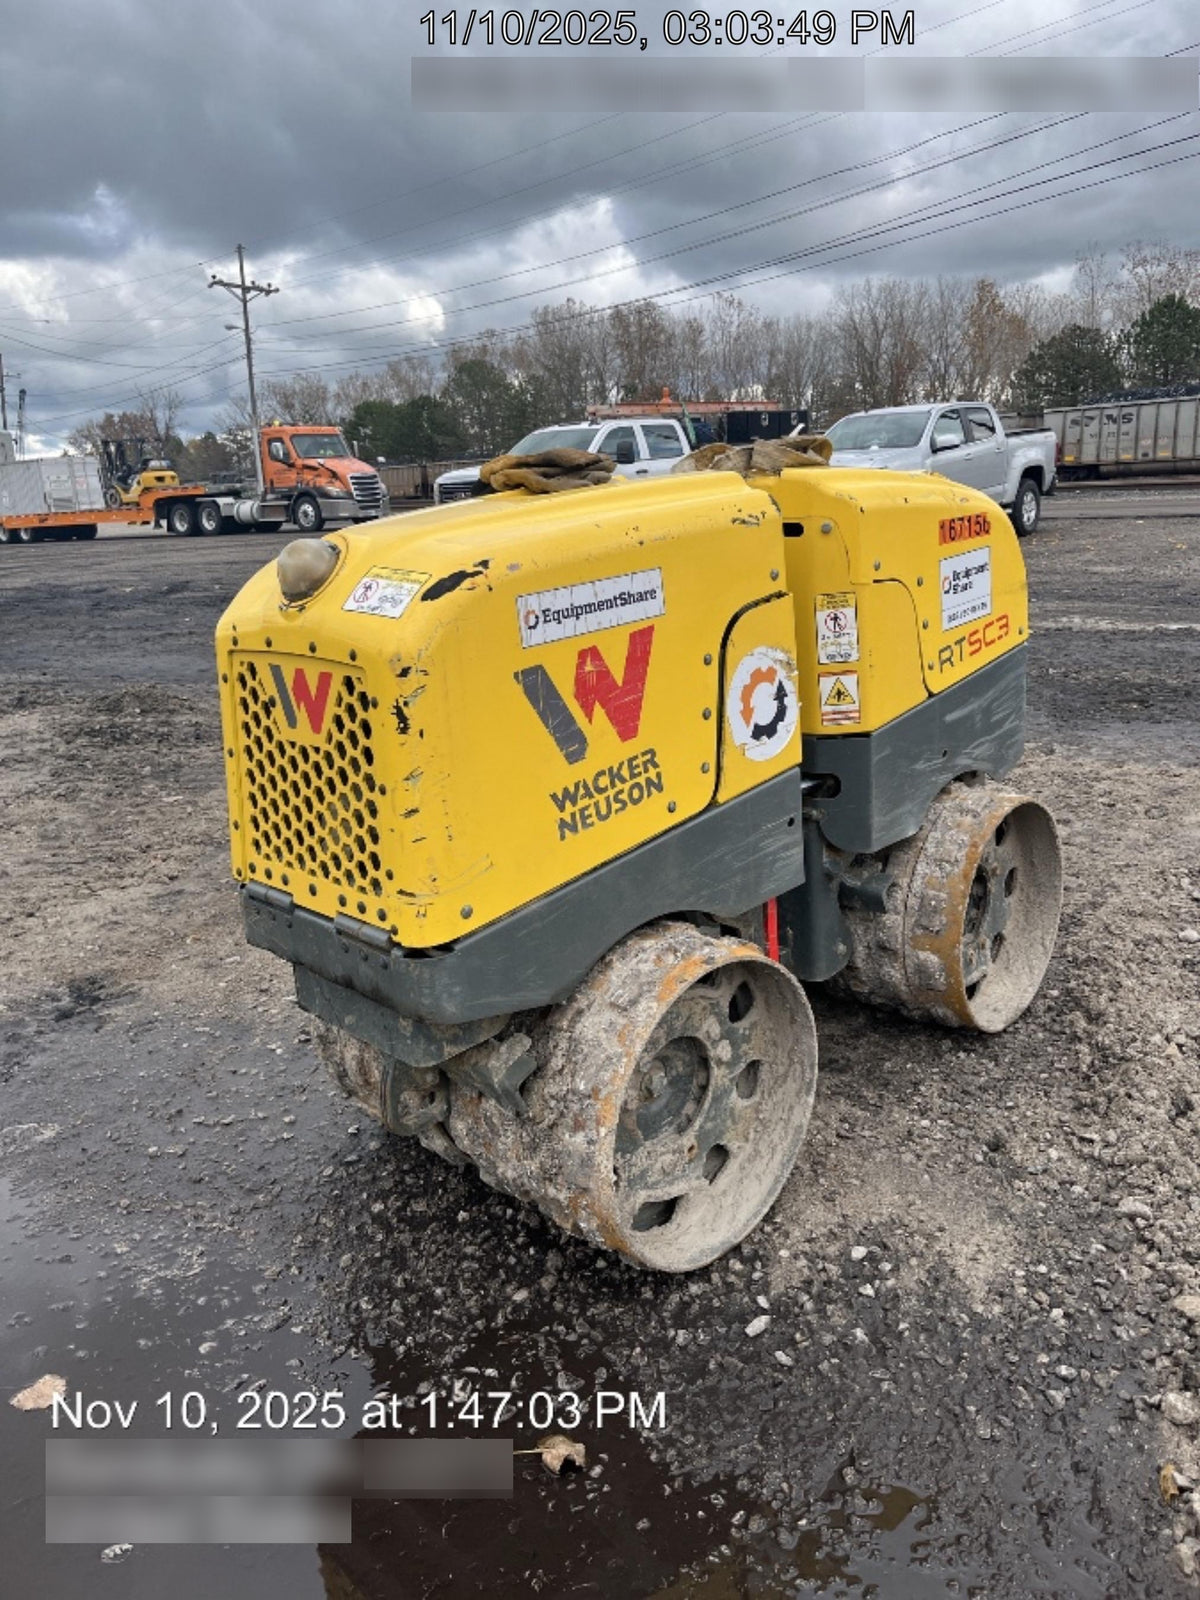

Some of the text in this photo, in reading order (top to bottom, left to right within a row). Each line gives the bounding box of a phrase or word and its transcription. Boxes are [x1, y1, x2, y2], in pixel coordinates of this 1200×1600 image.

[940, 513, 990, 543] 167156
[541, 587, 658, 625] EquipmentShare
[549, 747, 661, 814] WACKER
[556, 771, 665, 842] NEUSON
